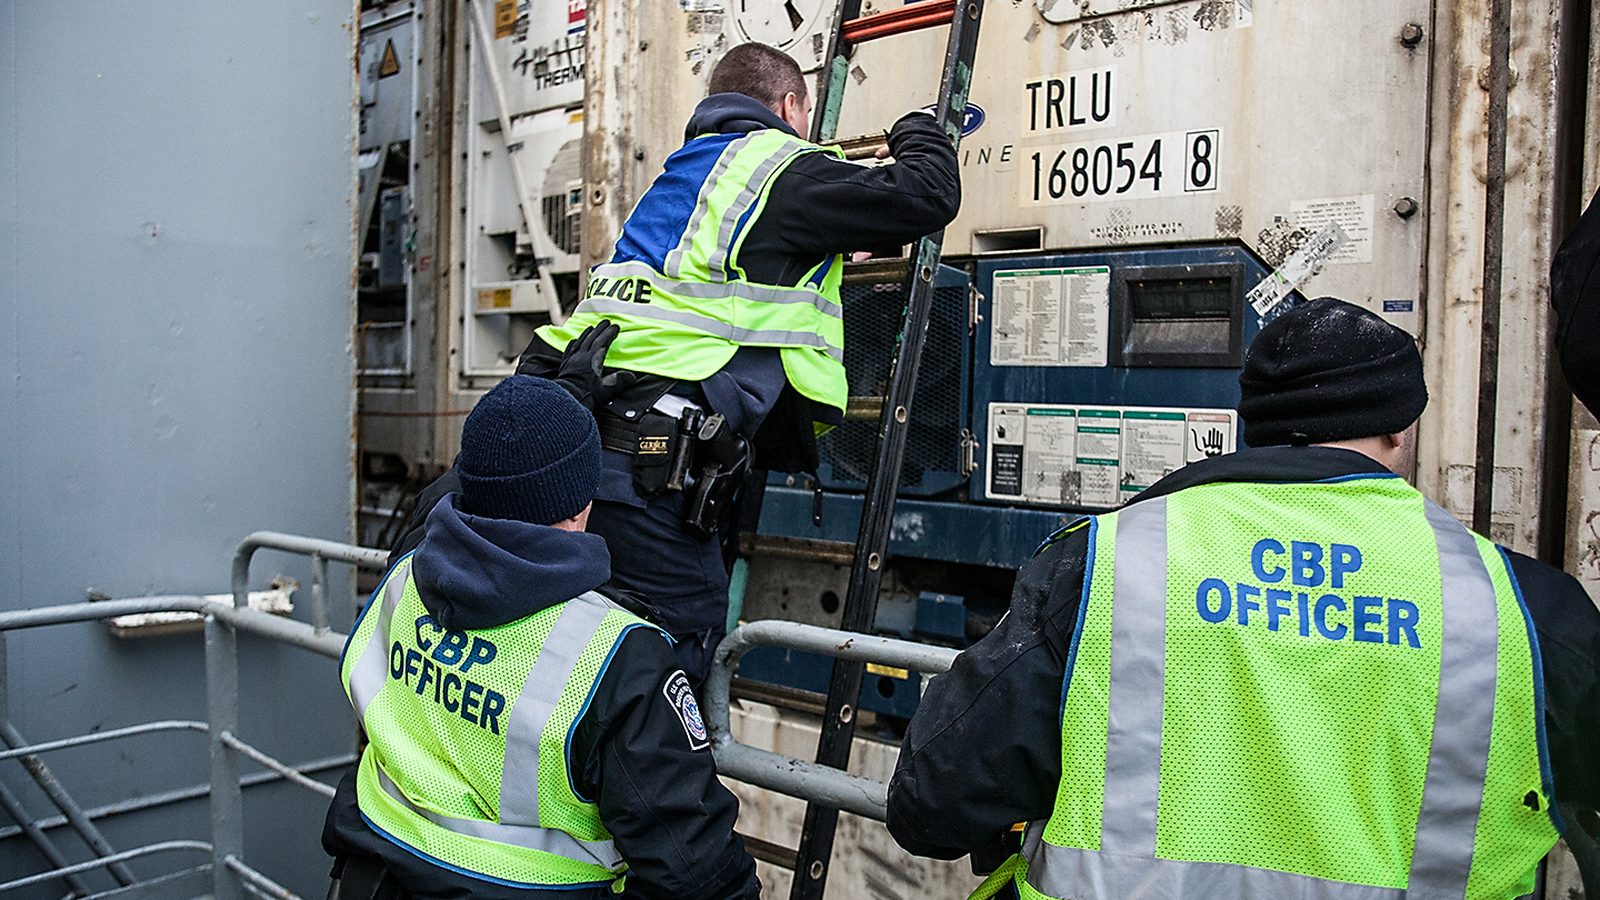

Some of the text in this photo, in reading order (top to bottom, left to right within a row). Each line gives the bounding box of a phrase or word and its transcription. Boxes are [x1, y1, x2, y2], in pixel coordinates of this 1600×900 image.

[1026, 71, 1111, 131] TRLU
[1031, 135, 1213, 201] 168054 8
[1251, 538, 1363, 589] CBP
[415, 614, 498, 673] CBP
[1195, 577, 1423, 649] OFFICER
[390, 640, 506, 736] OFFICER
